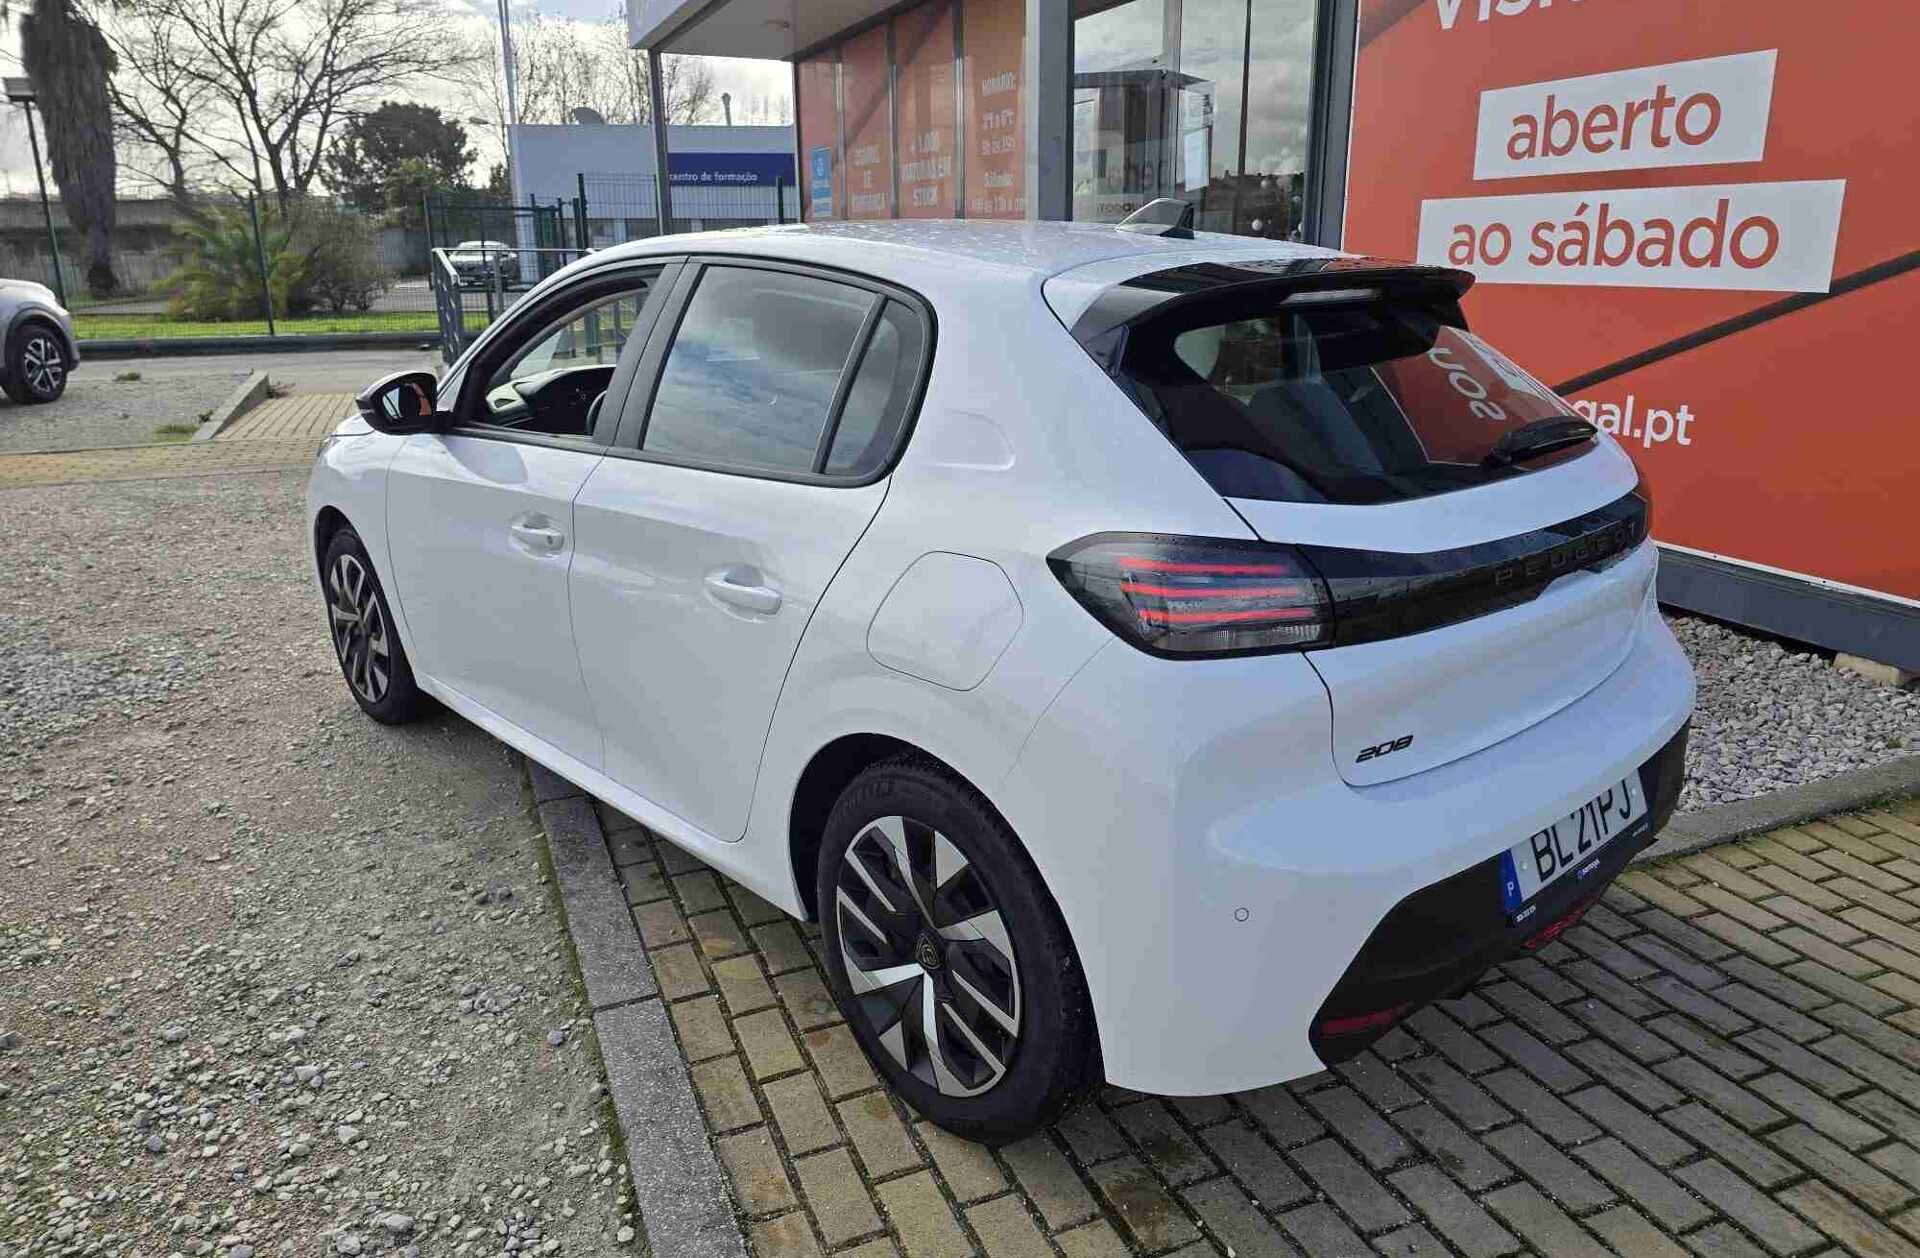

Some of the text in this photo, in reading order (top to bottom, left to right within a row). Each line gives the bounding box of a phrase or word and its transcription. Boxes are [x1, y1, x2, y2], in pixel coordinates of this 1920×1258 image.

[1507, 84, 1721, 160] aberto
[668, 171, 758, 184] centro de formação
[1448, 198, 1780, 270] ao sábado
[1355, 734, 1414, 763] 208
[1506, 880, 1515, 897] P
